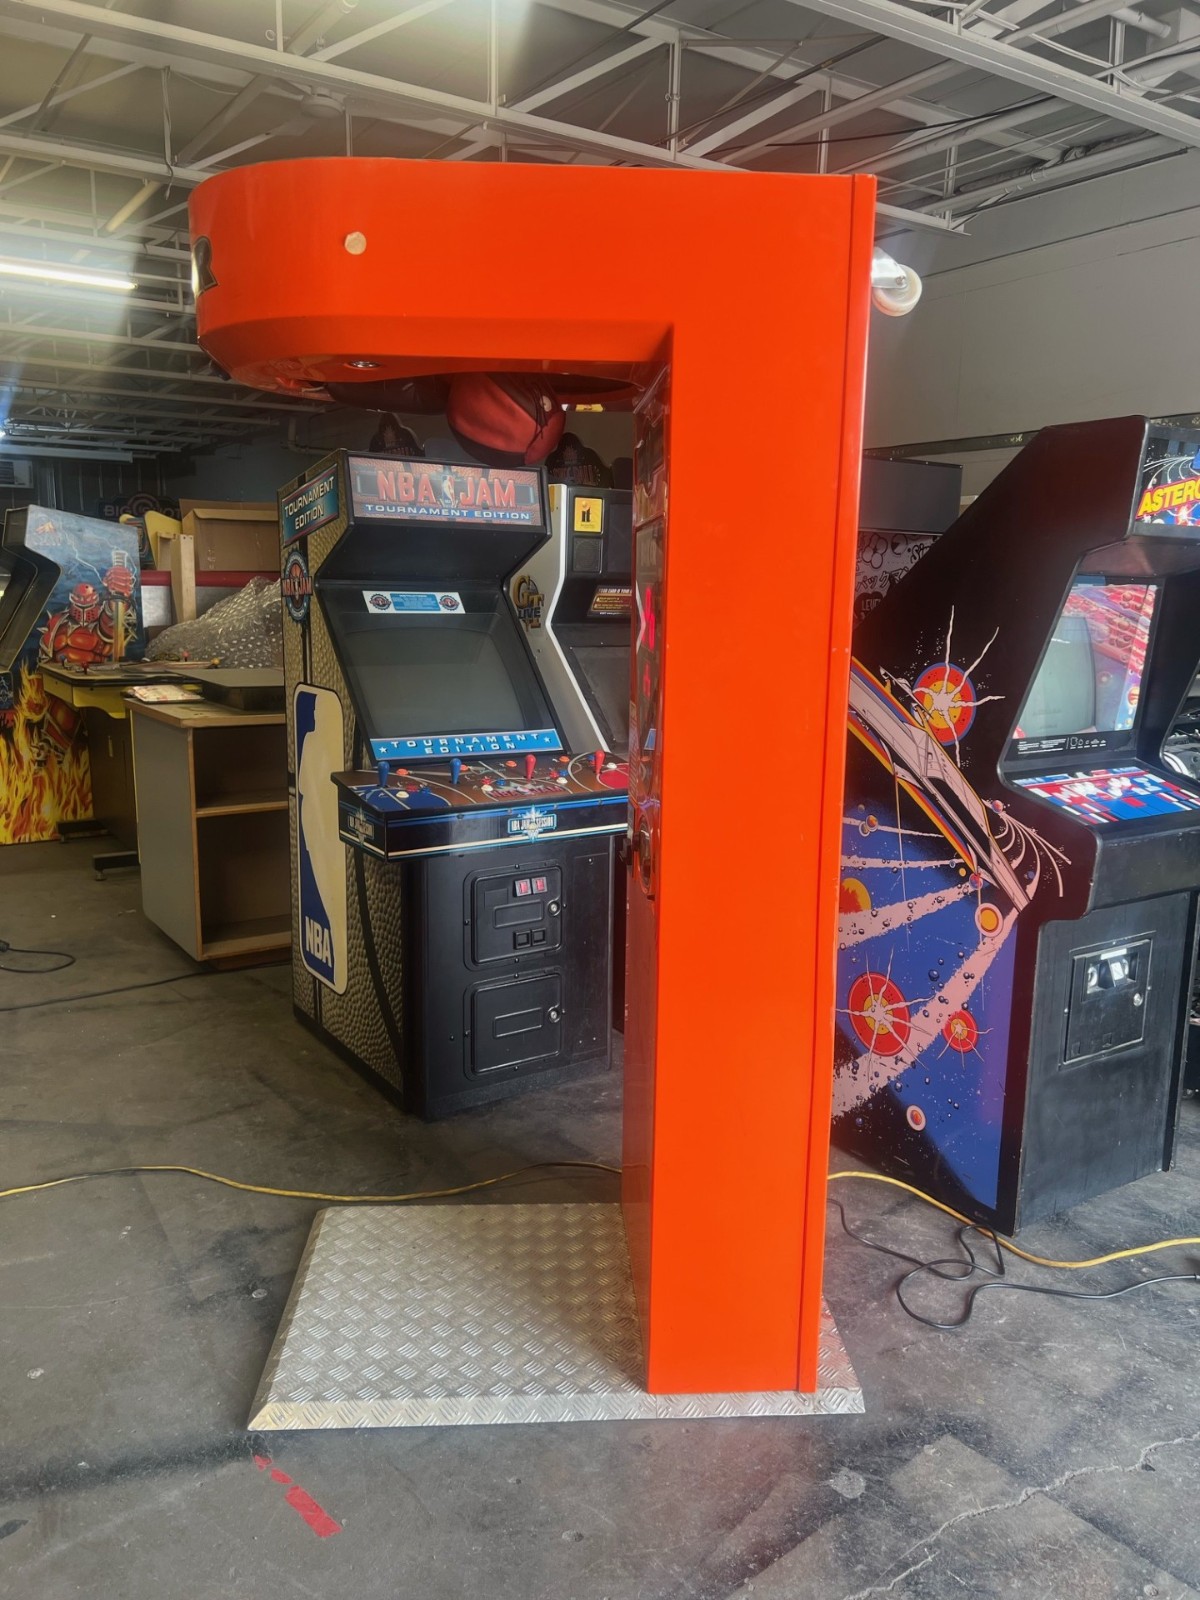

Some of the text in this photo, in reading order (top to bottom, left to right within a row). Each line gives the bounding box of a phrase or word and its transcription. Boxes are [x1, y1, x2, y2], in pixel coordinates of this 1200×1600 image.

[284, 476, 335, 518] TOURNAMENT
[376, 470, 518, 508] NBA JAM
[294, 504, 324, 530] EDITION
[366, 504, 531, 520] TOURNAMENT EDITION
[282, 578, 312, 596] NBA JAM
[518, 607, 541, 619] LIVE
[391, 733, 540, 749] TOURNAMENT
[424, 742, 516, 755] EDITION
[305, 915, 332, 968] NBA
